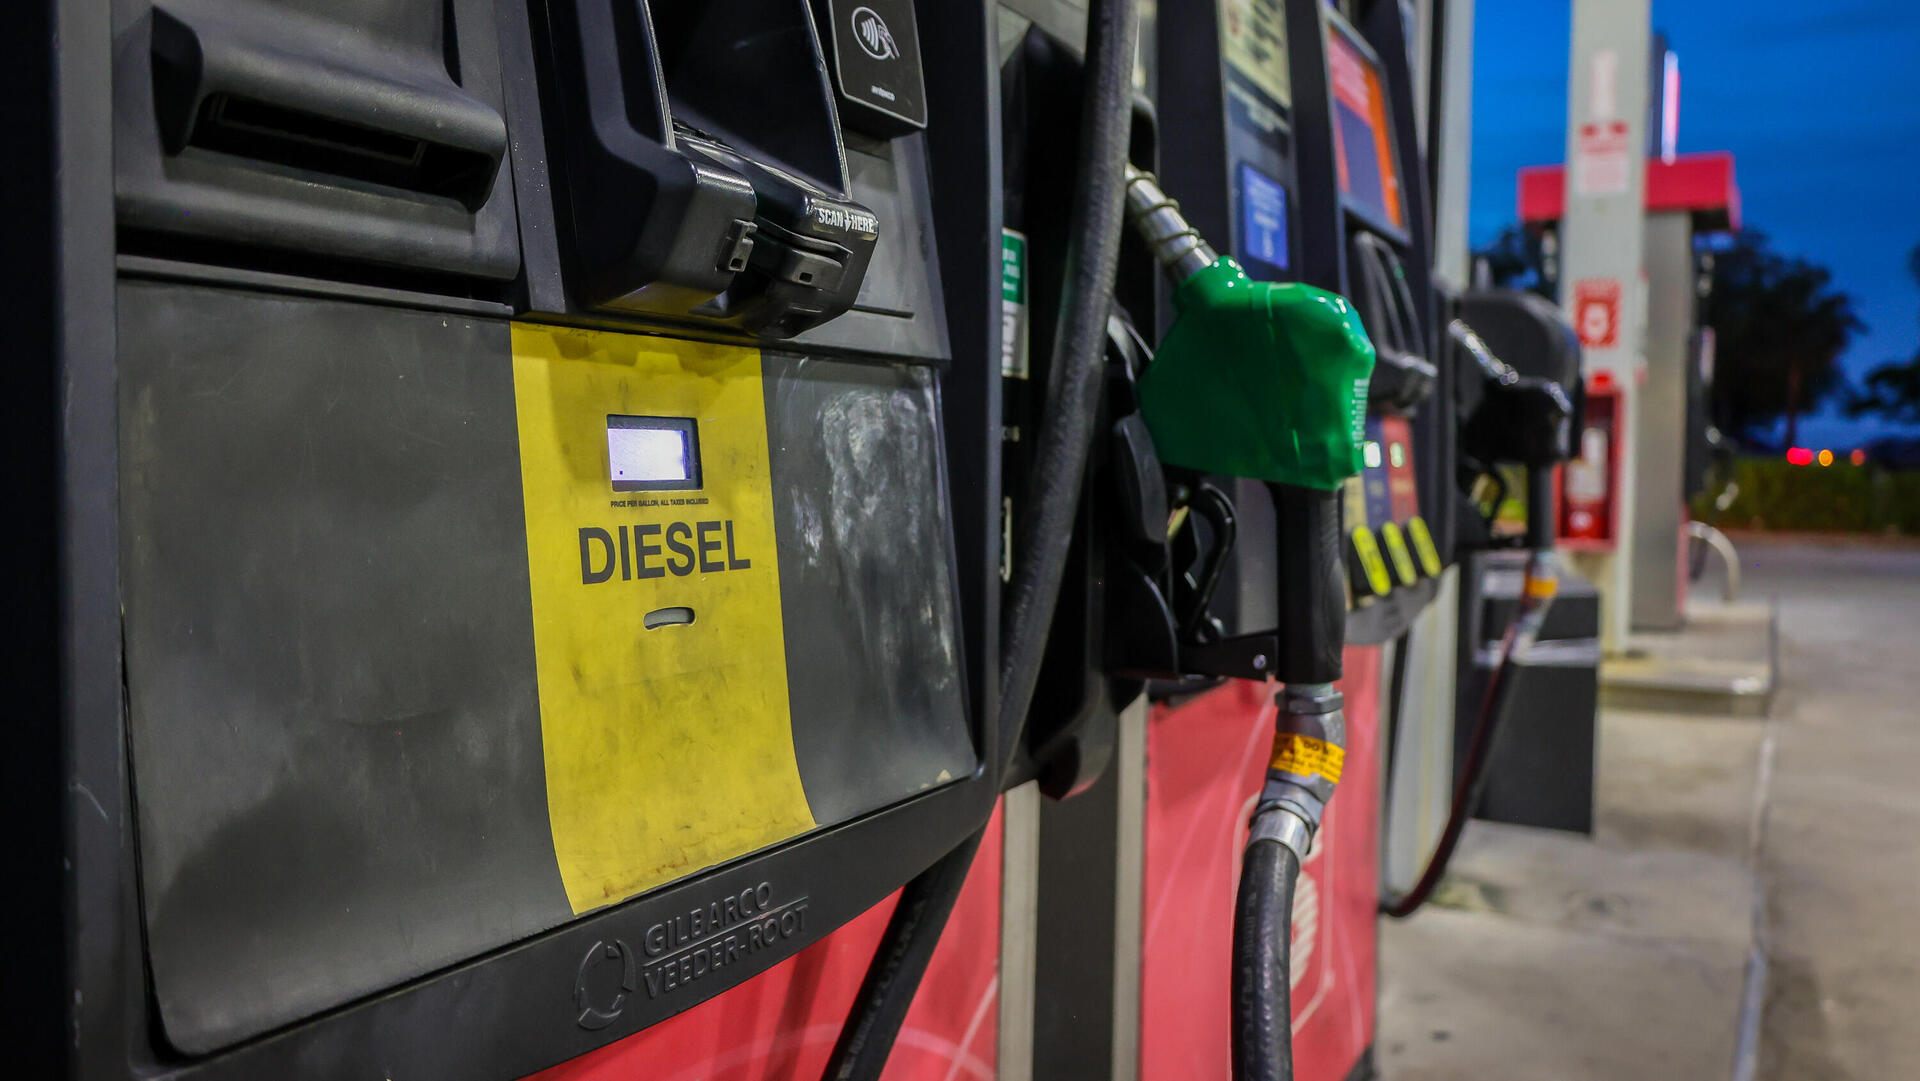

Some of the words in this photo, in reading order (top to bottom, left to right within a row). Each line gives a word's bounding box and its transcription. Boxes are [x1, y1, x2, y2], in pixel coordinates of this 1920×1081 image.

[818, 208, 844, 227] SCAN
[851, 214, 875, 233] HERE
[610, 500, 626, 508] PRICE
[578, 520, 751, 585] DIESEL
[643, 904, 809, 999] VEEDER-ROOT
[644, 881, 773, 958] GILBARCO
